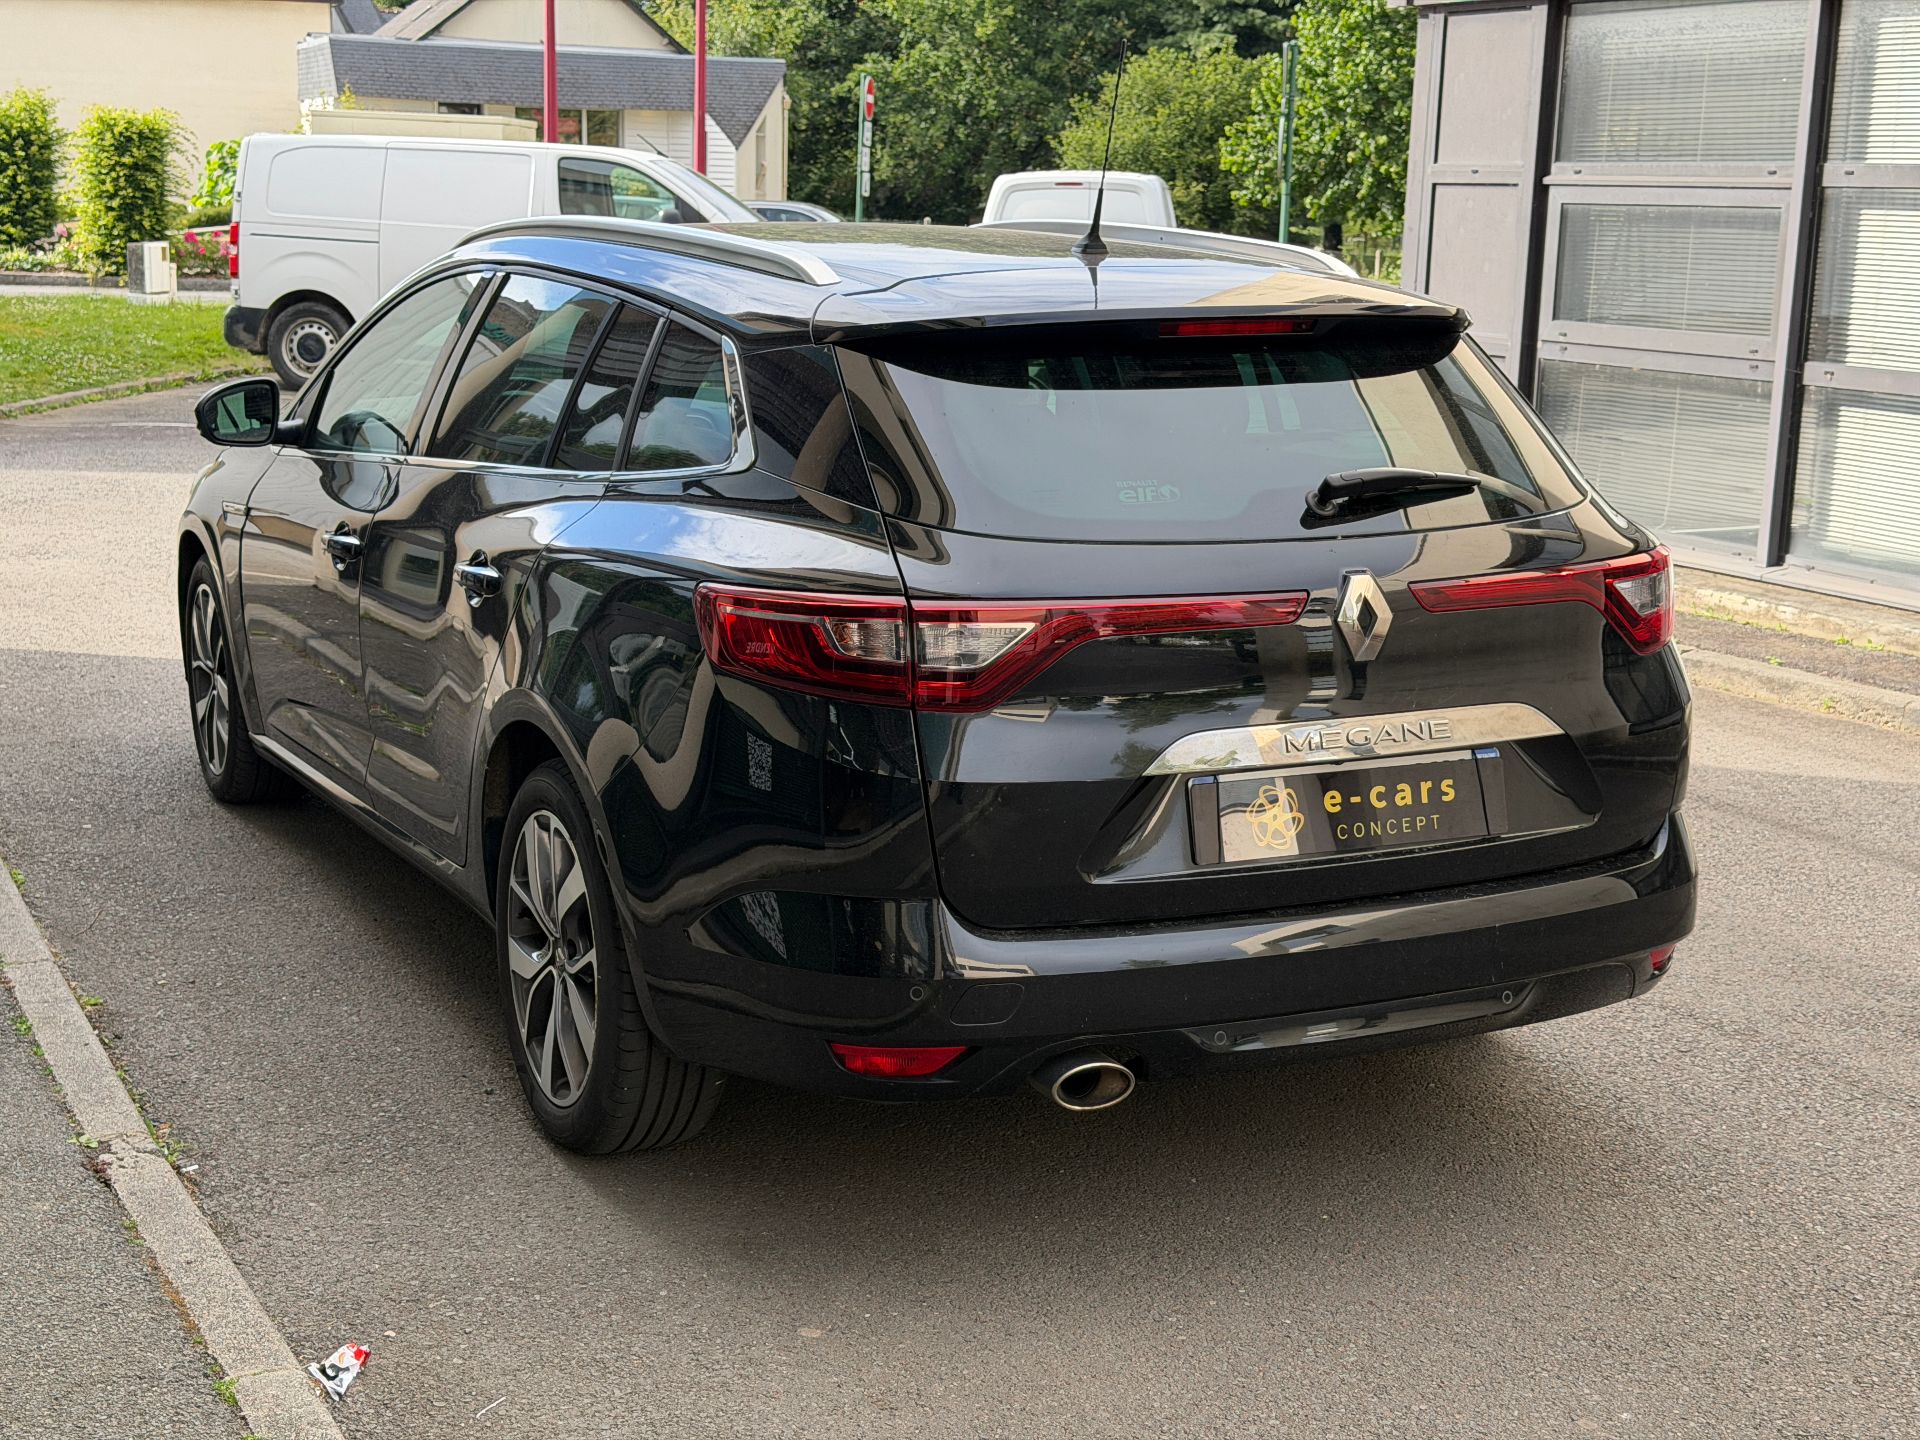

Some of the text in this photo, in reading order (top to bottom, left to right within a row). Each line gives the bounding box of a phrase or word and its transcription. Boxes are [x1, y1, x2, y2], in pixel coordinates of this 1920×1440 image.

[1119, 487, 1156, 503] elf
[1284, 719, 1451, 753] MEGANE
[1323, 778, 1456, 813] e-cars
[1337, 814, 1440, 840] CONCEPT
